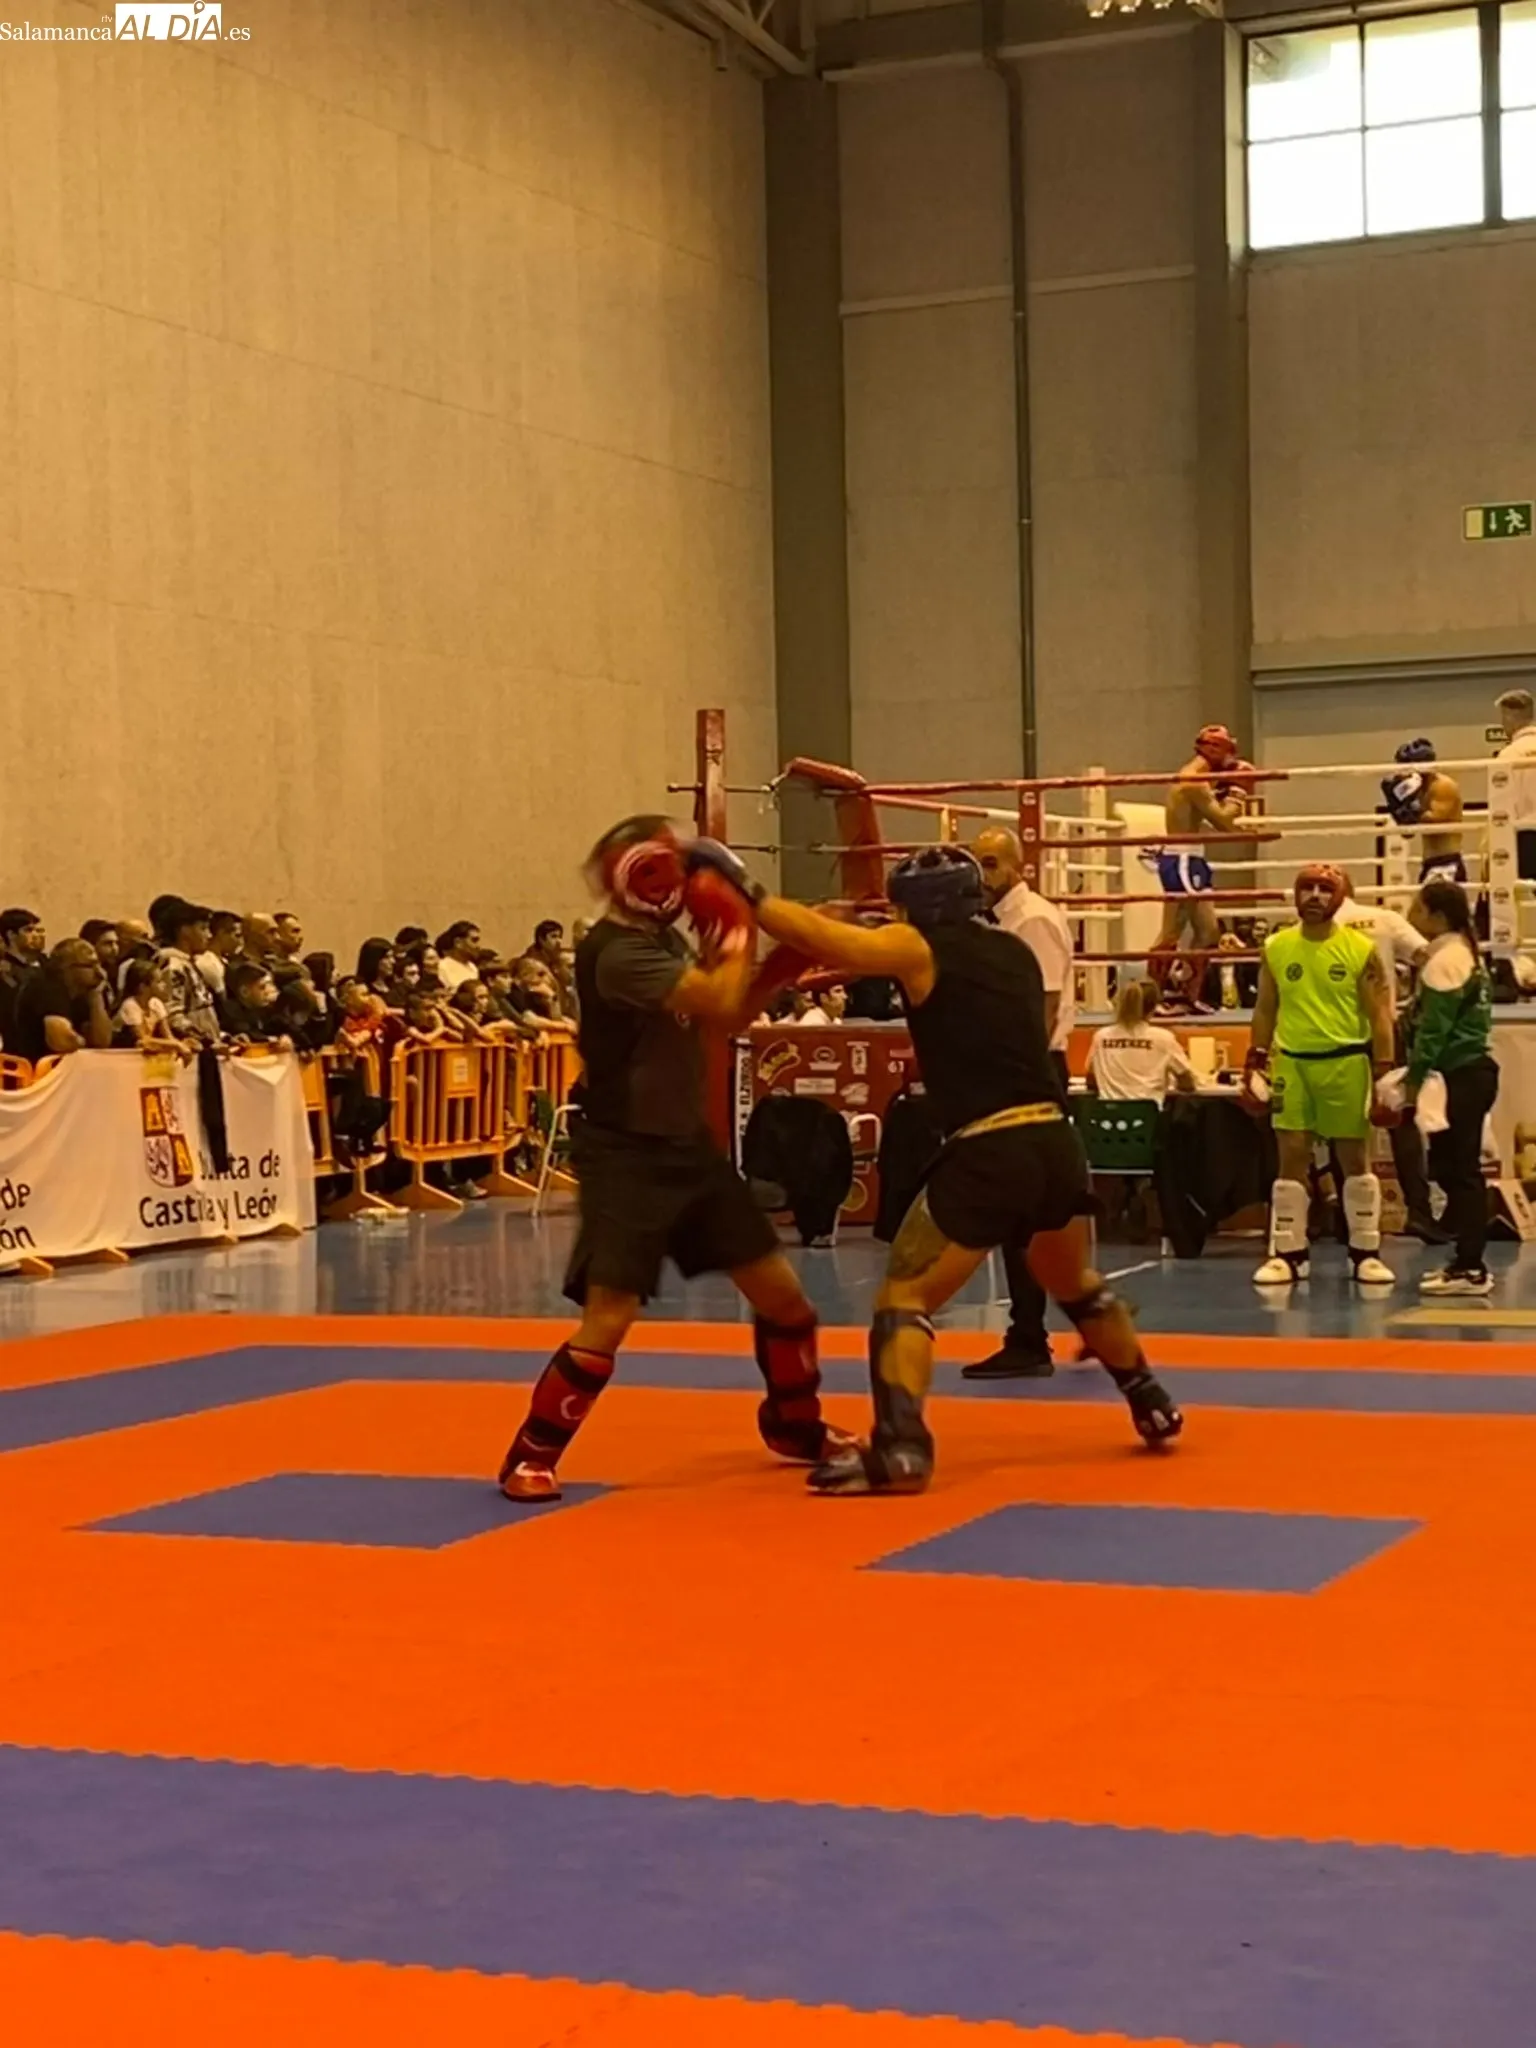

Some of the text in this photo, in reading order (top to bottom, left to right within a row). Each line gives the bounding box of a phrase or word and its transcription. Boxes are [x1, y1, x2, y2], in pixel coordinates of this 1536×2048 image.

[259, 1148, 280, 1178] de
[0, 1178, 31, 1211] de
[217, 1198, 229, 1230] y
[0, 1219, 36, 1250] ón
